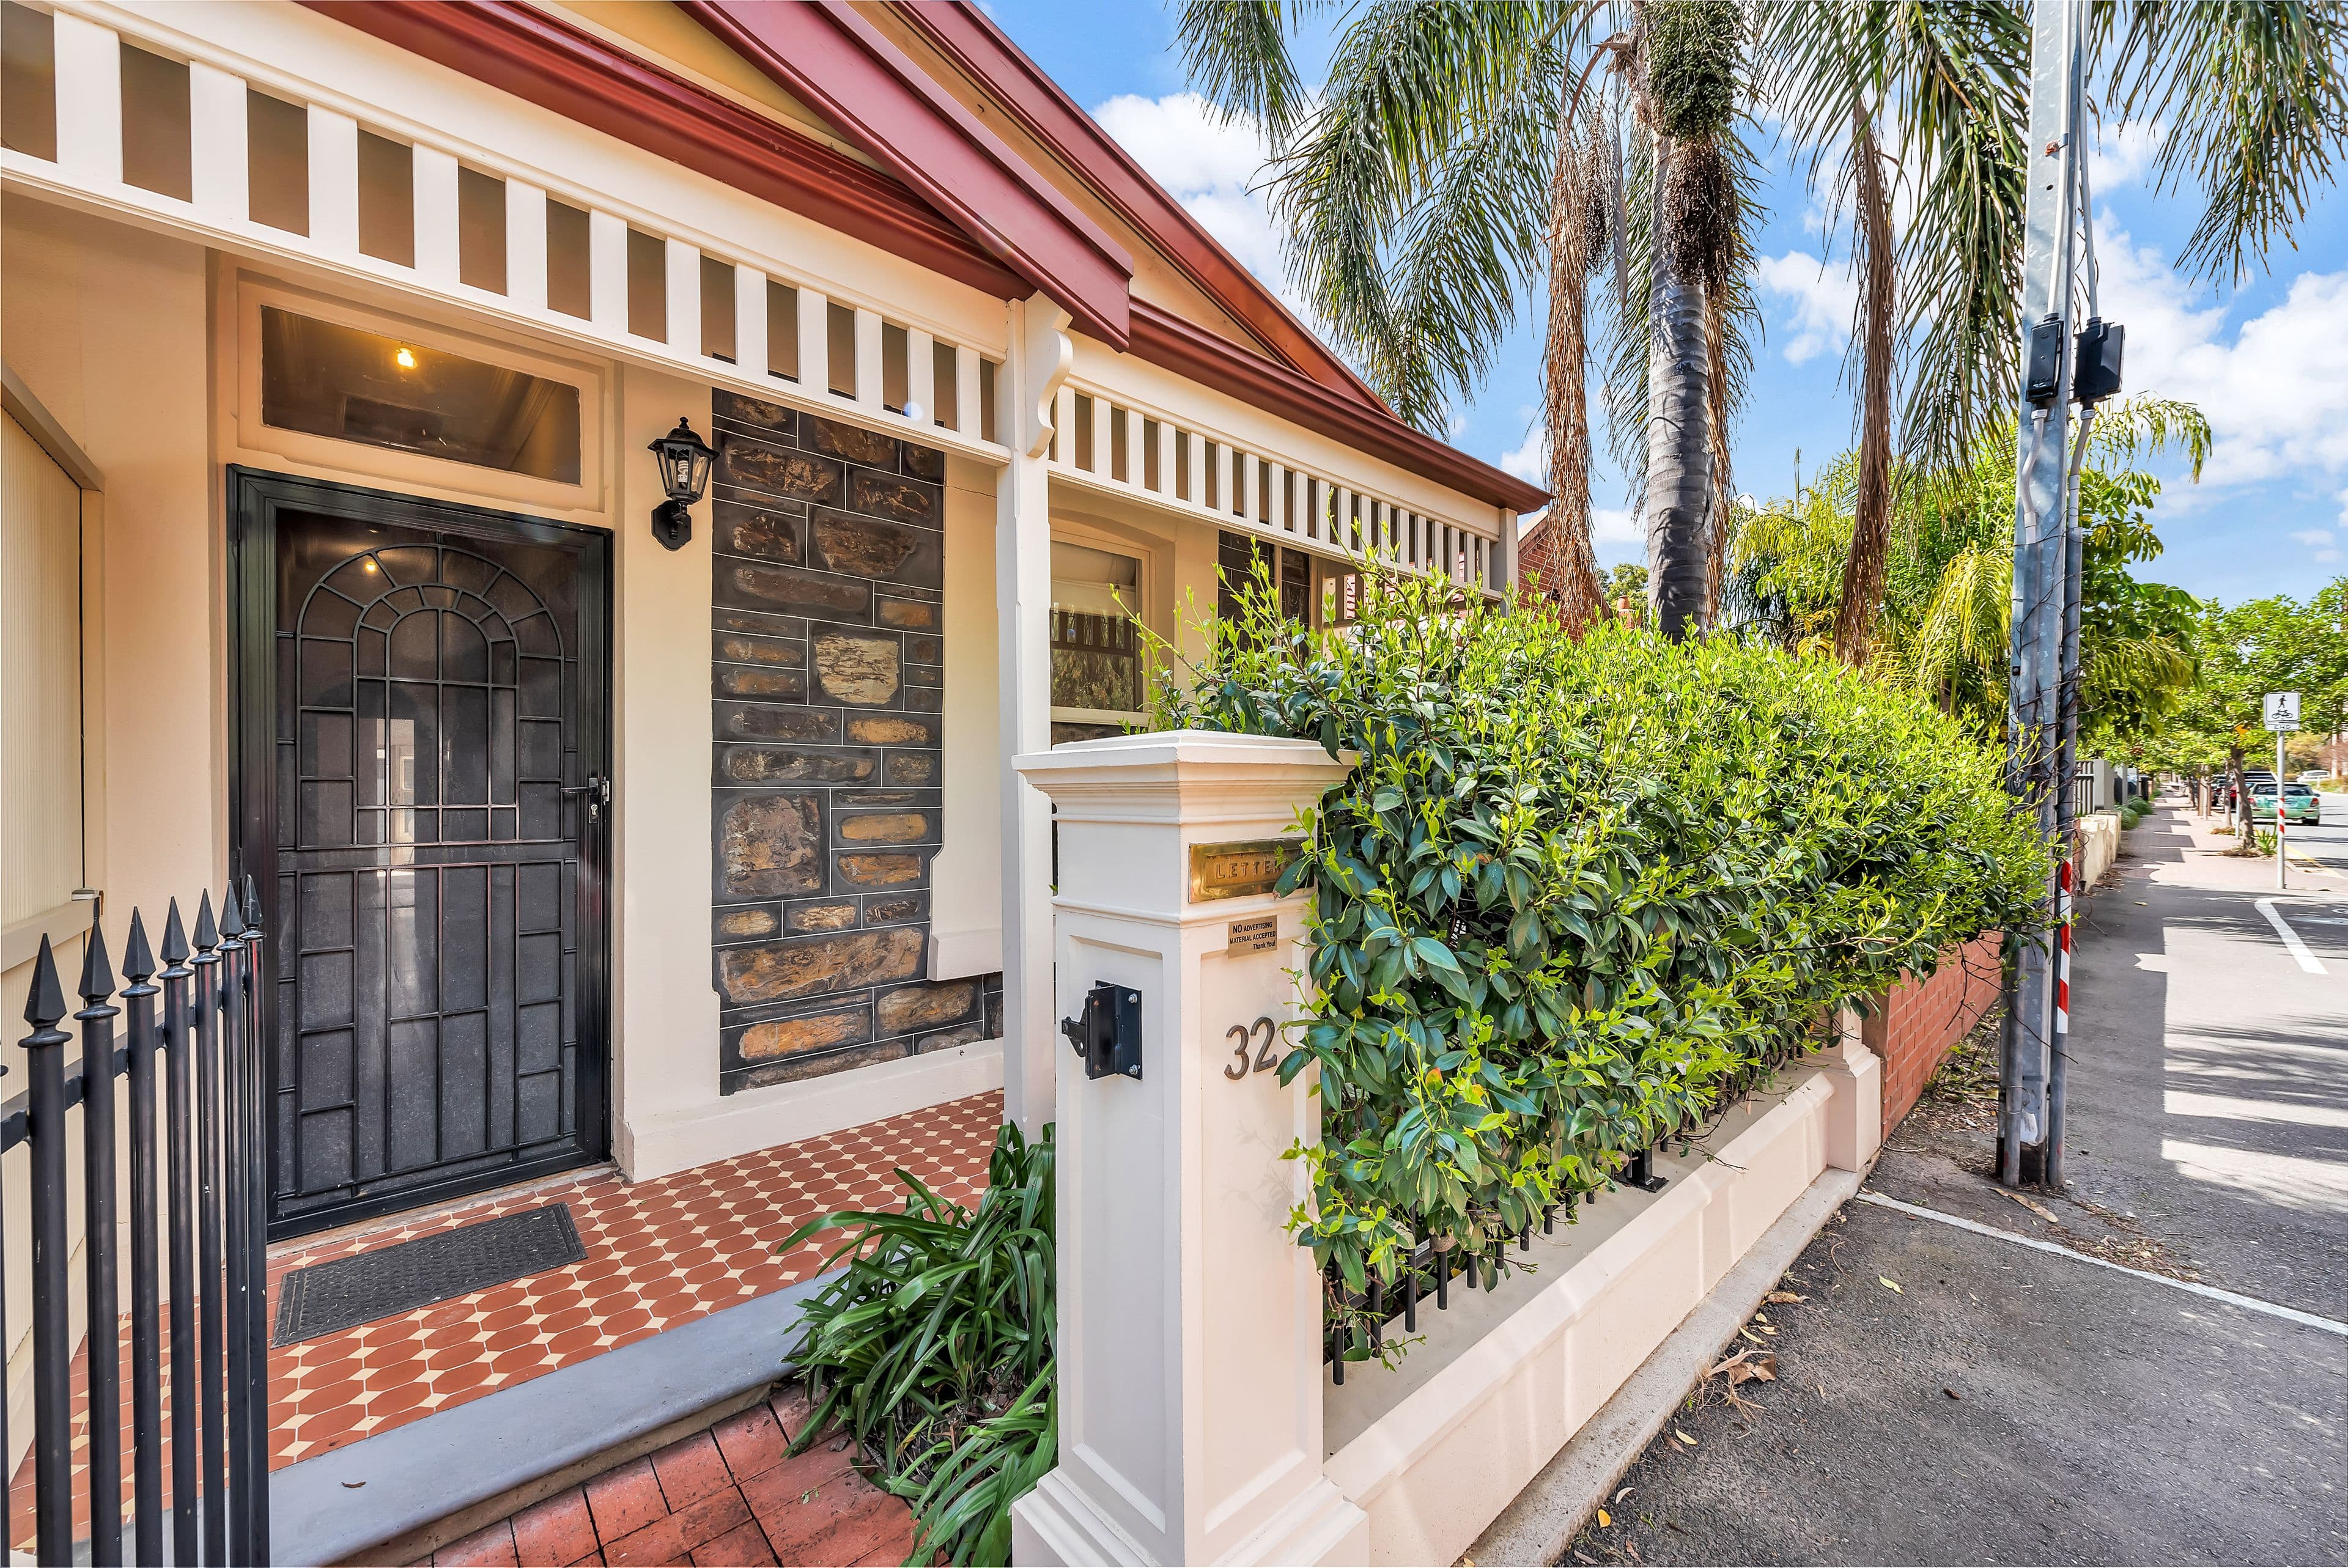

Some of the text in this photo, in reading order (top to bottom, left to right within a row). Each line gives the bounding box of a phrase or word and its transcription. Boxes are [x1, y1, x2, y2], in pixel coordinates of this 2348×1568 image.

[1233, 921, 1272, 934] NO ADVERTISING
[1229, 931, 1276, 944] MATERIAL ACCEPTED
[1224, 1017, 1277, 1080] 32
